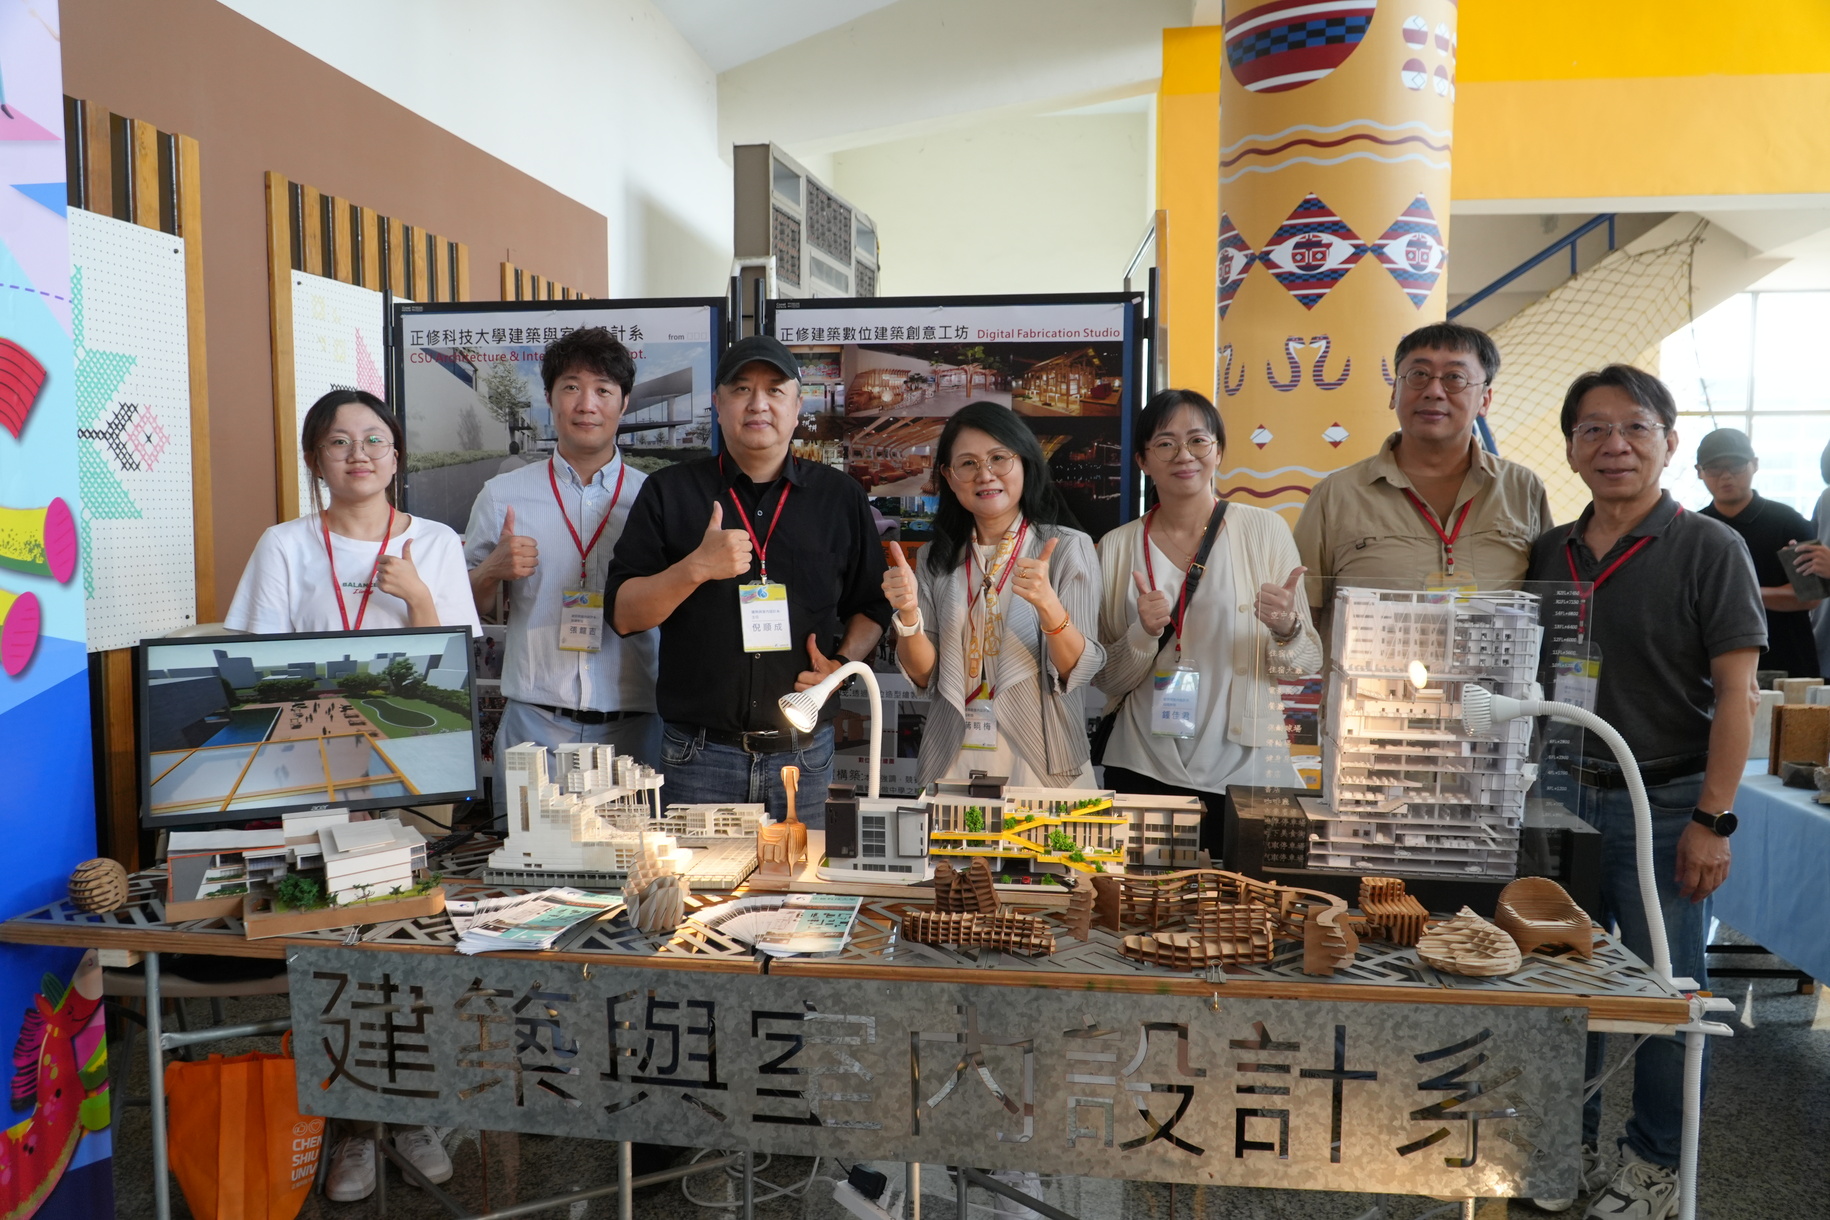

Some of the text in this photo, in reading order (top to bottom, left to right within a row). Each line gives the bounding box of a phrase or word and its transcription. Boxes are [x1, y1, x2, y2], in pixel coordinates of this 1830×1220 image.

[668, 333, 685, 341] from
[780, 325, 969, 342] 正修建築數位建築創意工坊
[977, 327, 1120, 341] Digital Fabrication Studio
[410, 349, 647, 364] CSU Architecture & Inte pt.
[312, 971, 1545, 1169] 建築與室內設計系
[292, 1135, 323, 1152] CHEN
[291, 1161, 319, 1182] UNIV
